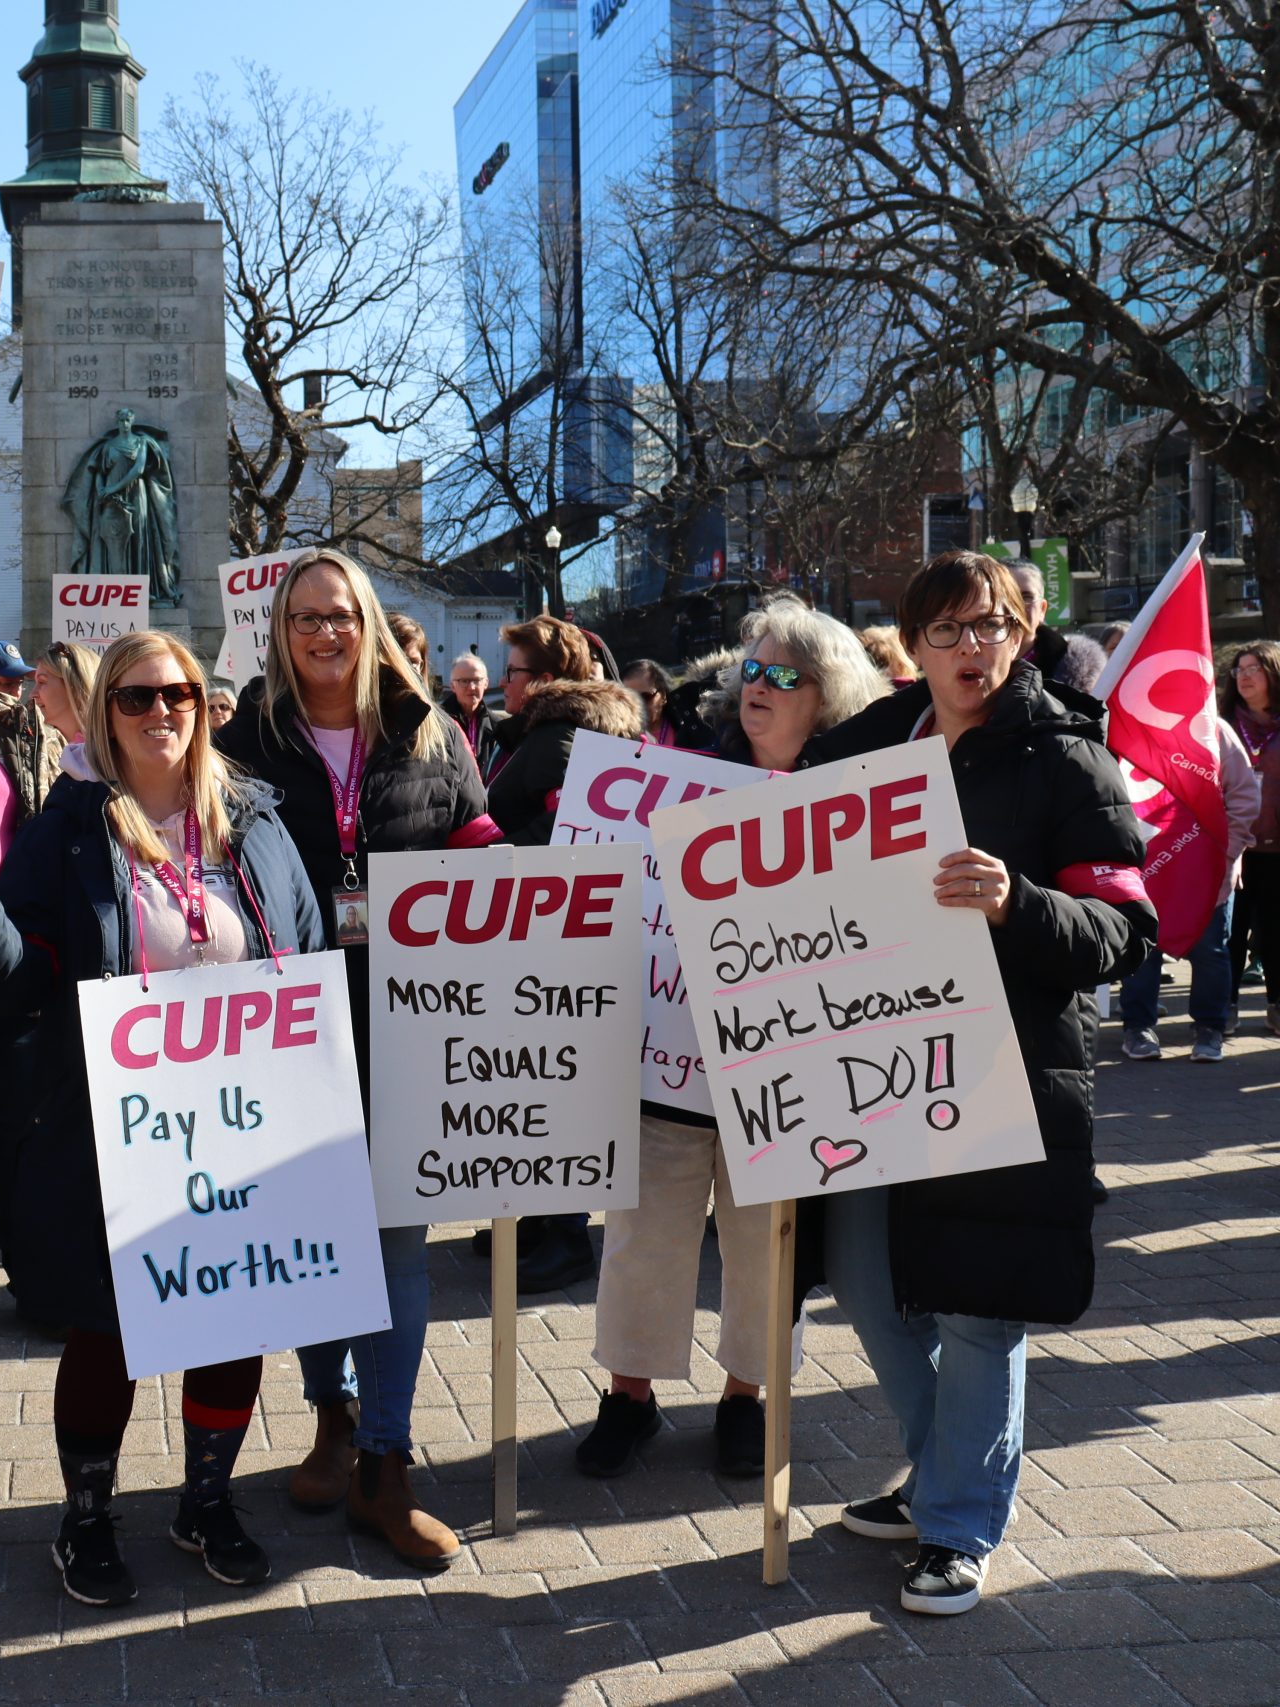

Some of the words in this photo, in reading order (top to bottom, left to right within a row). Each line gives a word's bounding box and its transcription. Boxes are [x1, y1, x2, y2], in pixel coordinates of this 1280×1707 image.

[46, 277, 94, 289] THOSE
[101, 276, 135, 288] WHO
[143, 276, 198, 288] SERVED
[88, 260, 152, 273] HONOUR
[160, 260, 178, 272] OF
[56, 324, 104, 335] THOSE
[112, 323, 146, 335] WHO
[153, 323, 190, 335] FELL
[66, 308, 82, 319] IN
[88, 307, 155, 319] MEMORY
[160, 307, 179, 319] OF
[68, 354, 99, 366] 1914
[148, 353, 179, 366] 1918
[68, 370, 98, 382] 1939
[67, 386, 99, 398] 1950
[147, 386, 179, 398] 1953
[59, 584, 142, 607] CUPE
[227, 562, 289, 595] CUP
[1046, 553, 1060, 611] HALIFAX
[65, 619, 96, 639] PAY
[101, 621, 122, 638] US
[231, 608, 256, 626] PAY
[587, 766, 728, 829] CU
[680, 773, 928, 902] CUPE
[192, 899, 201, 918] SCFP
[388, 874, 624, 947] CUPE
[710, 906, 869, 984] Schools
[387, 976, 487, 1016] MORE
[513, 976, 619, 1018] STAFF
[713, 1005, 816, 1055] Work
[818, 977, 966, 1031] because
[111, 983, 321, 1069] CUPE
[445, 1036, 577, 1083] EQUALS
[731, 1073, 806, 1146] WE
[837, 1033, 961, 1131] DO!
[119, 1093, 198, 1162] Pay
[220, 1085, 263, 1131] Us
[441, 1101, 549, 1139] MORE
[416, 1140, 616, 1197] SUPPORTS!
[186, 1172, 260, 1216] Our
[141, 1238, 340, 1304] Worth!!!
